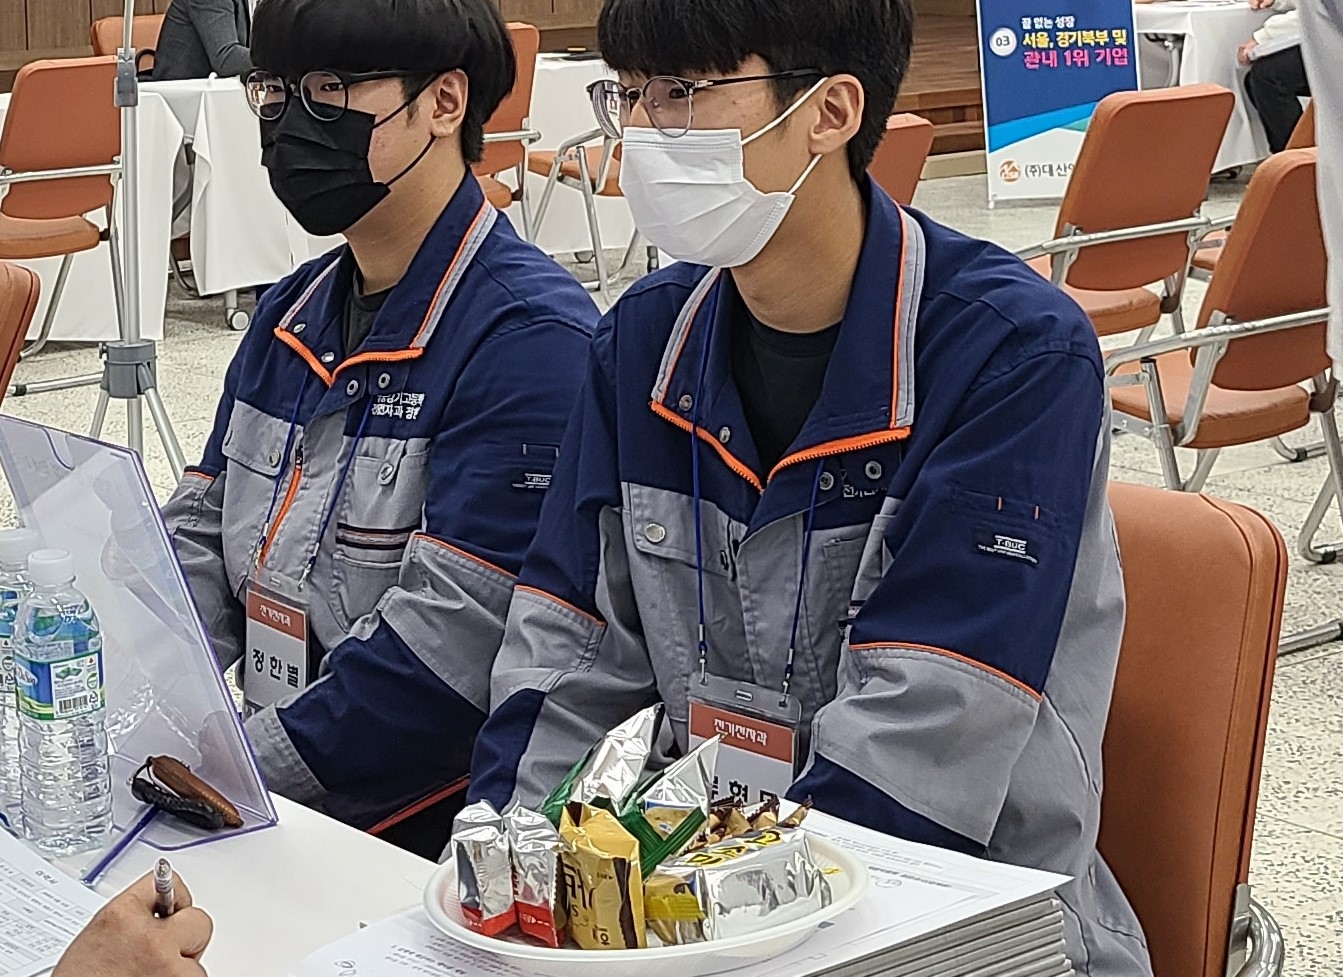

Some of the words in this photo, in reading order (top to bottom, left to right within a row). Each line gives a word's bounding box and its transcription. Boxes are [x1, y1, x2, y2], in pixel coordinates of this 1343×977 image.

[995, 35, 1010, 47] 03
[1022, 31, 1054, 49] 서울,
[1056, 29, 1110, 48] 경기북부
[1111, 28, 1127, 46] 및
[1023, 49, 1058, 70] 관내
[1063, 48, 1089, 68] 1위
[1094, 47, 1128, 67] 기업
[714, 718, 768, 746] 전기전자과
